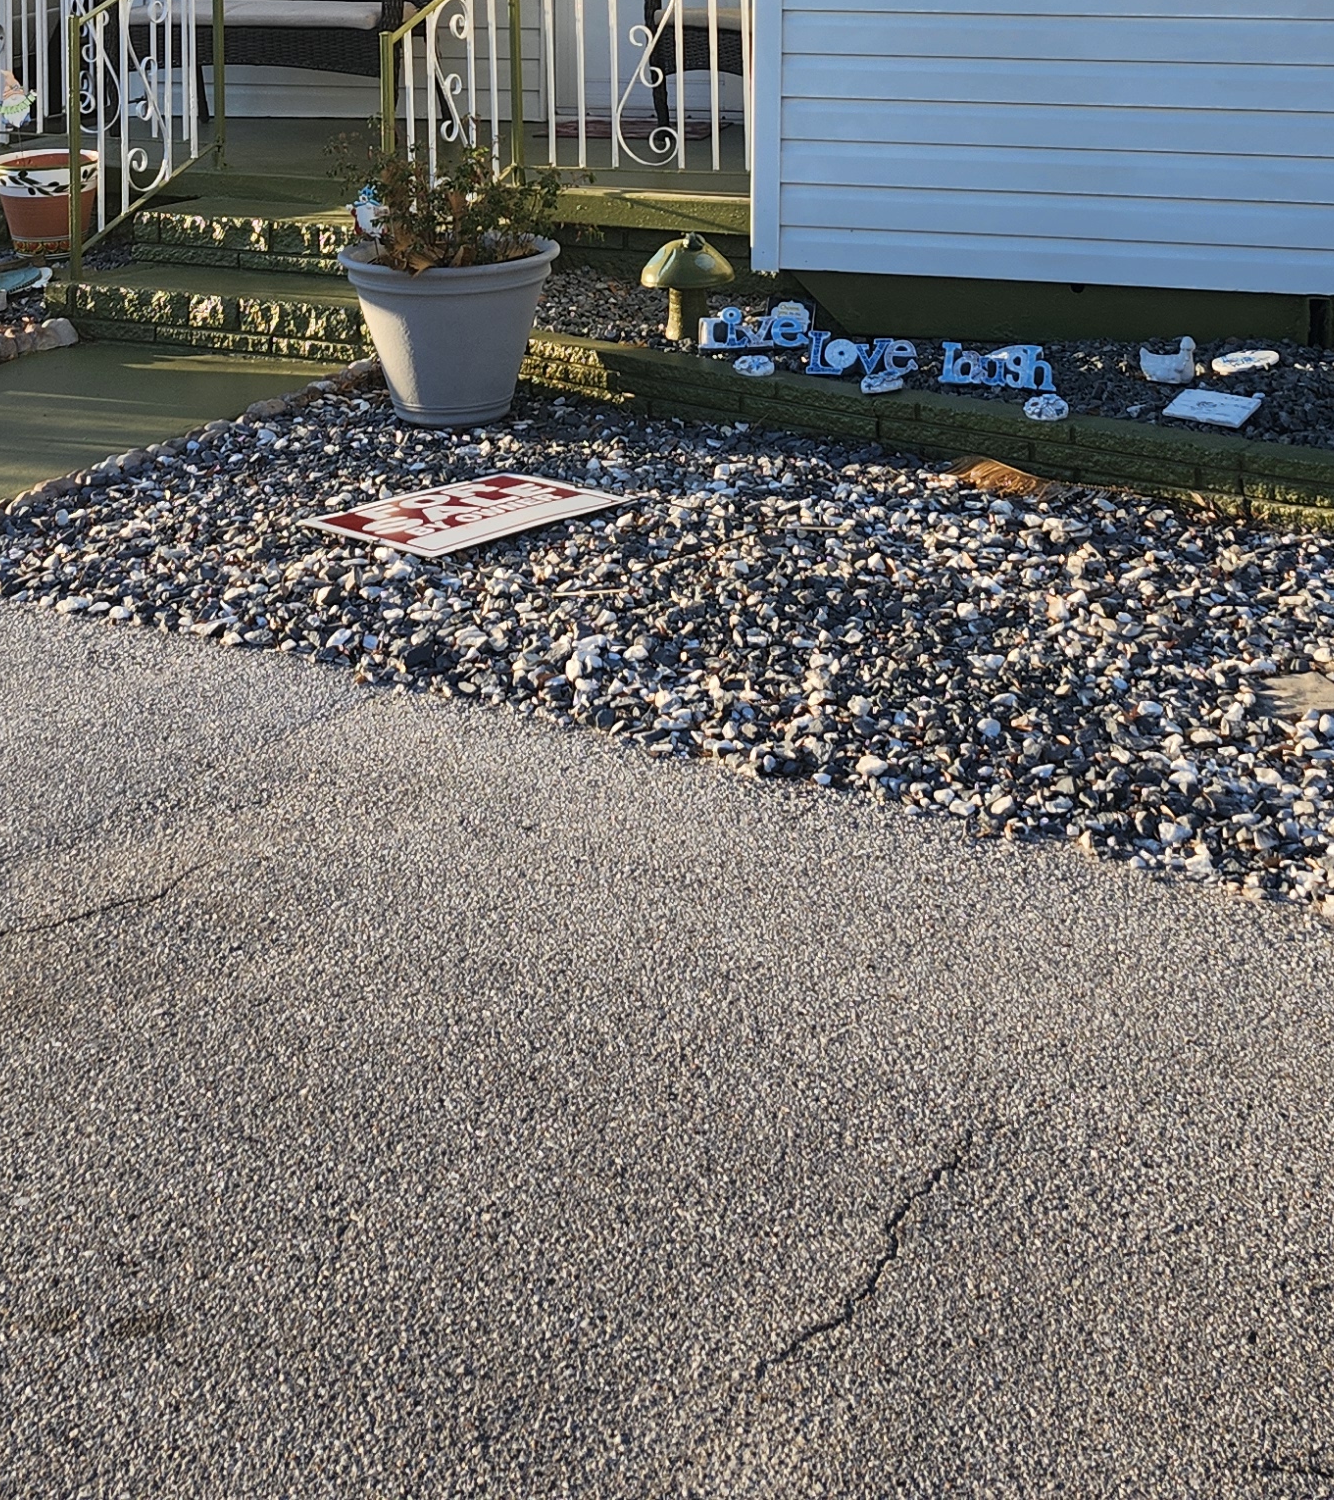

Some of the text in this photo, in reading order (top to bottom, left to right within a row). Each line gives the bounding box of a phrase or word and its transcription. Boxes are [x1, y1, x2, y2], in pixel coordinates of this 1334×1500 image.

[355, 482, 499, 521] FOR
[361, 482, 557, 535] SALE
[404, 493, 563, 536] BY OWNER
